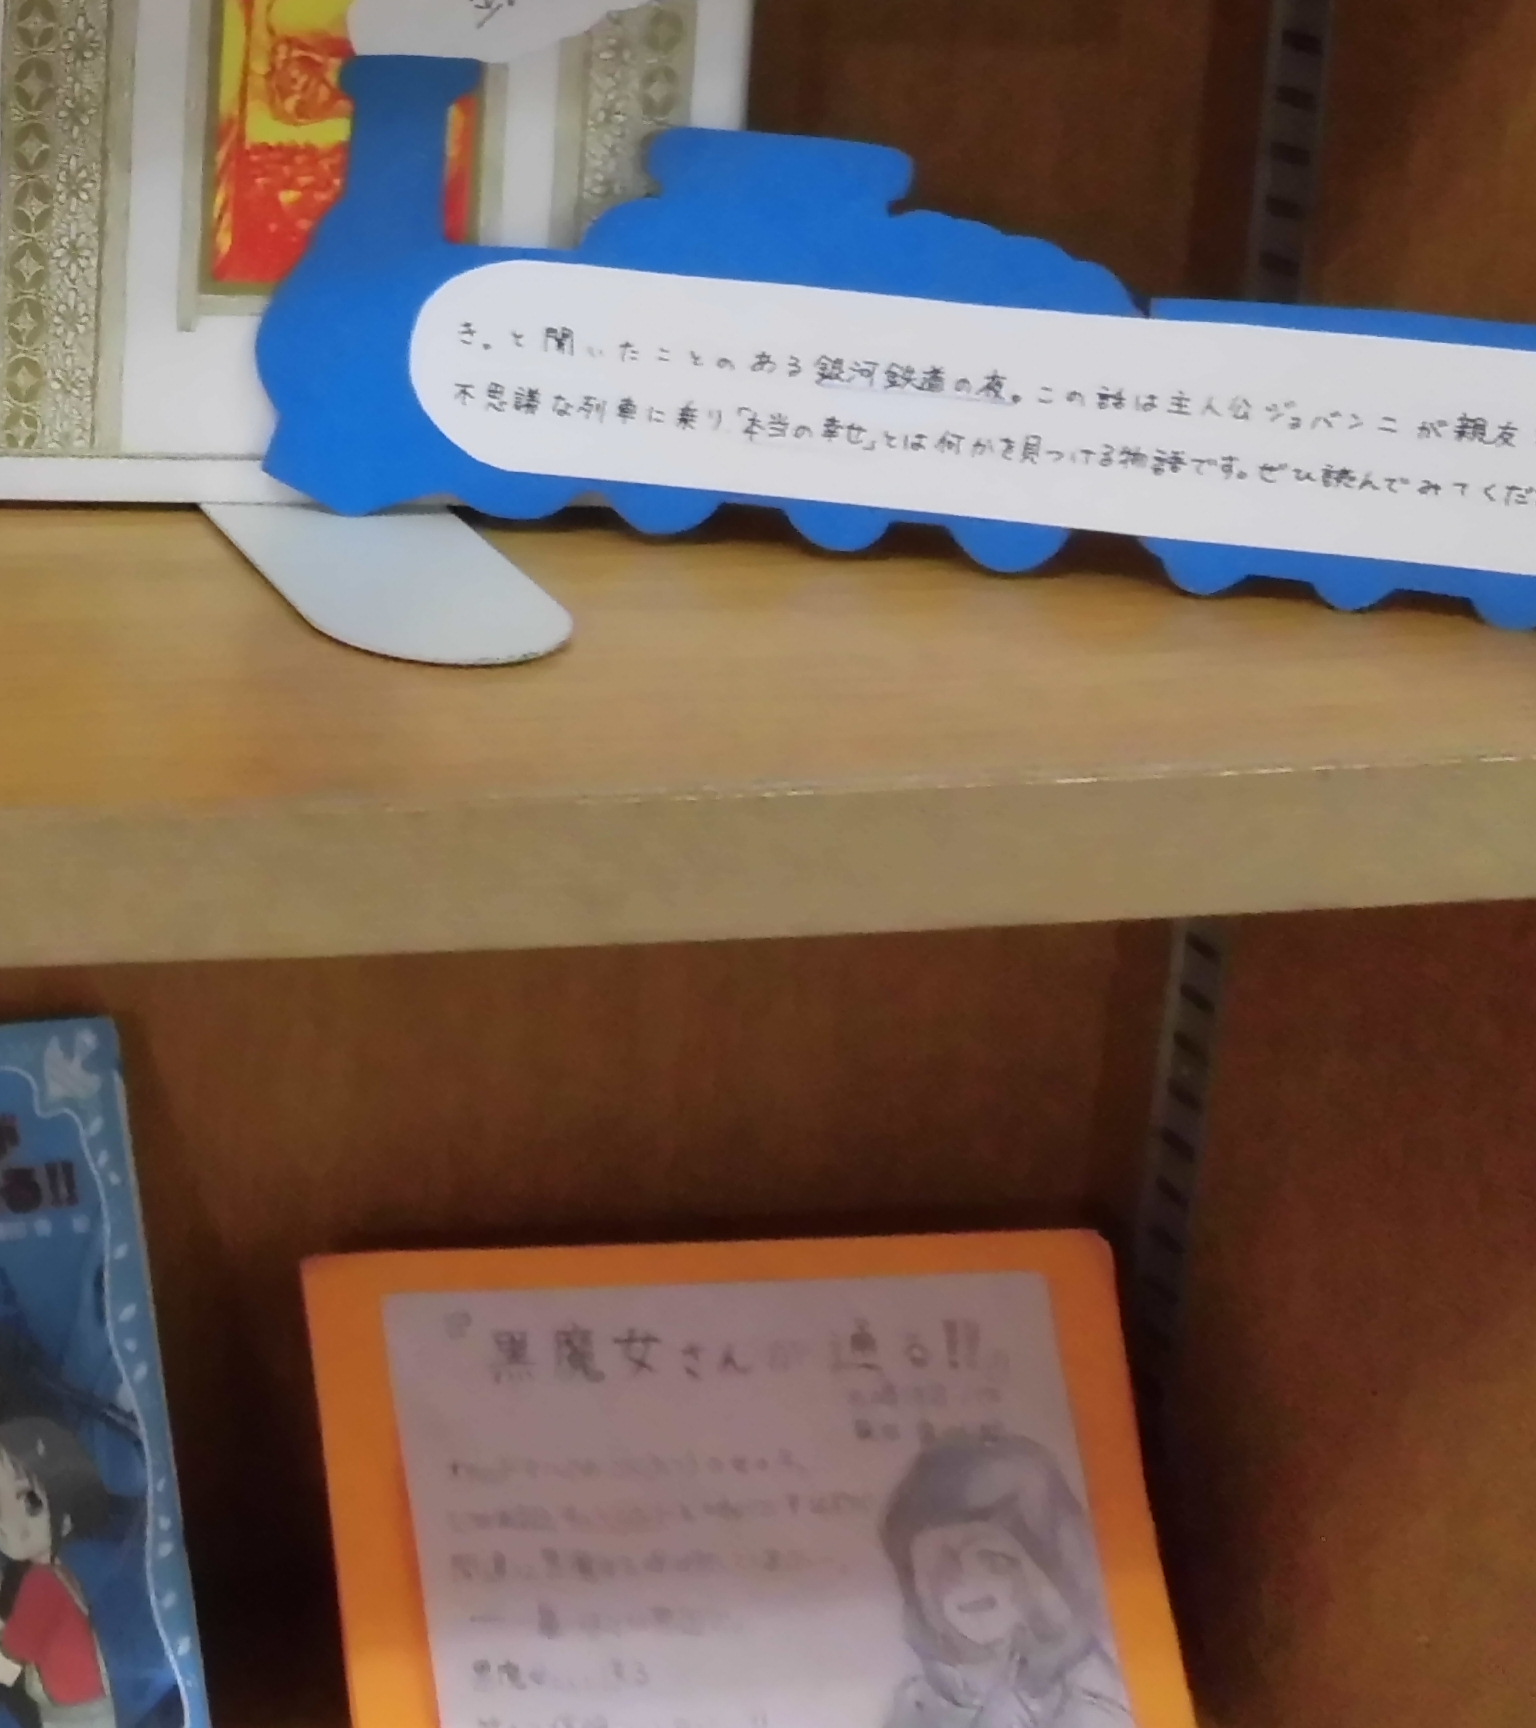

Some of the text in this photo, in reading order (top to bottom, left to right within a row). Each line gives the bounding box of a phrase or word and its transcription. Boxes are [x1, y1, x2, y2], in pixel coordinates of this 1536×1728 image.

[456, 319, 1536, 450] きっと聞いたことのある銀河鉄道の夜。この話は主人公ジョバンニが親友
